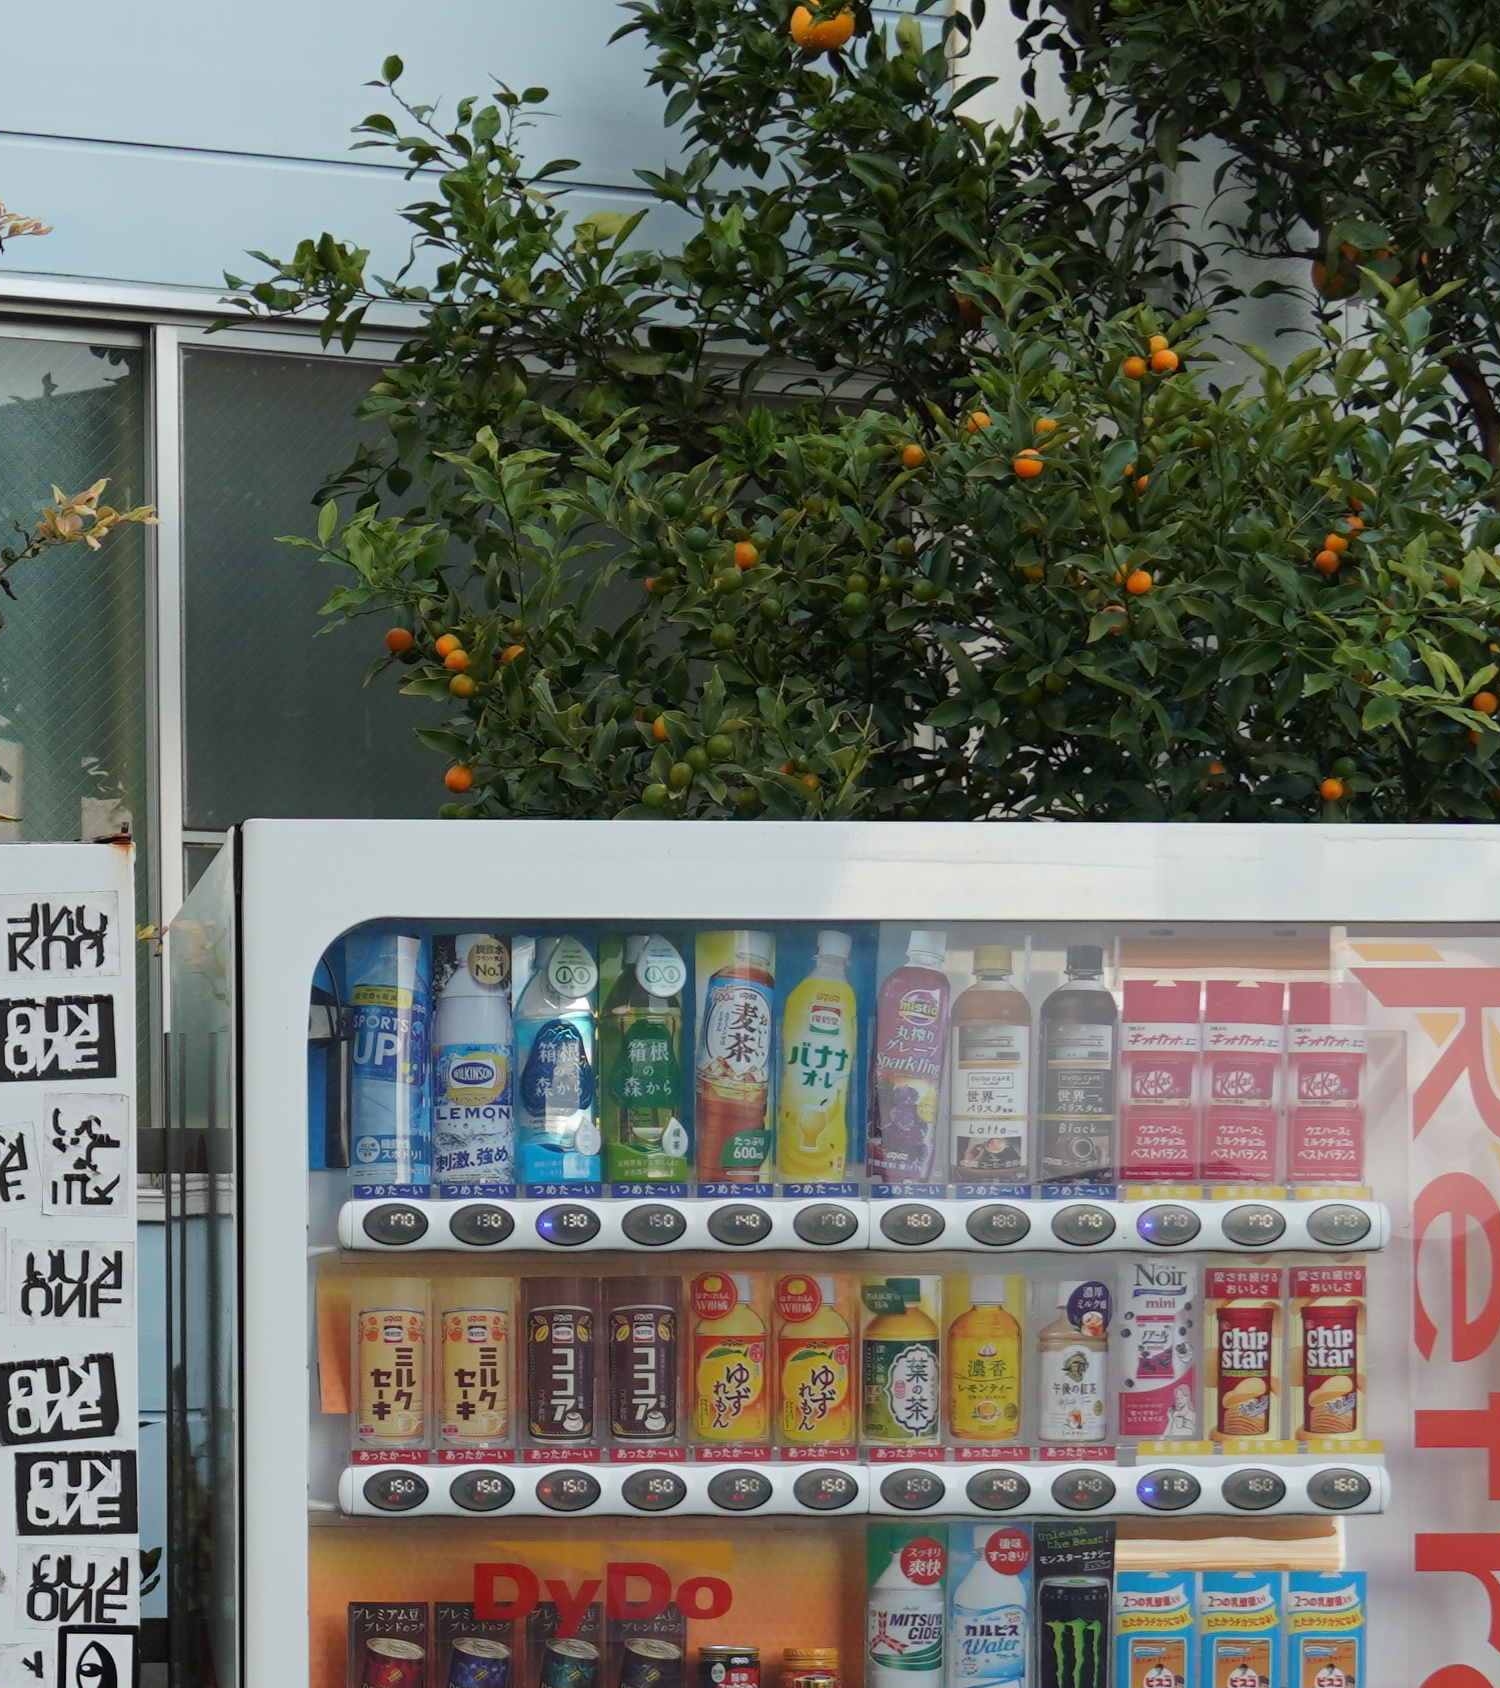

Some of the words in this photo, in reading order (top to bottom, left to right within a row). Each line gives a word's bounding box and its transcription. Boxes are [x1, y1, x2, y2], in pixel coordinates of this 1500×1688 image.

[725, 1003, 758, 1064] 麦茶
[353, 1031, 402, 1066] UP
[788, 1047, 850, 1068] バナナ
[435, 1105, 510, 1121] LEMON
[968, 1122, 1008, 1136] Latte
[1135, 1263, 1188, 1289] Noir
[1221, 1328, 1270, 1355] chip
[1221, 1347, 1268, 1371] star
[957, 1381, 1015, 1396] レモンティー
[472, 1562, 734, 1638] DyDo
[887, 1611, 944, 1628] MITSUYA
[907, 1625, 944, 1640] CIDER
[964, 1622, 1021, 1639] カルピス
[962, 1636, 1020, 1658] Water
